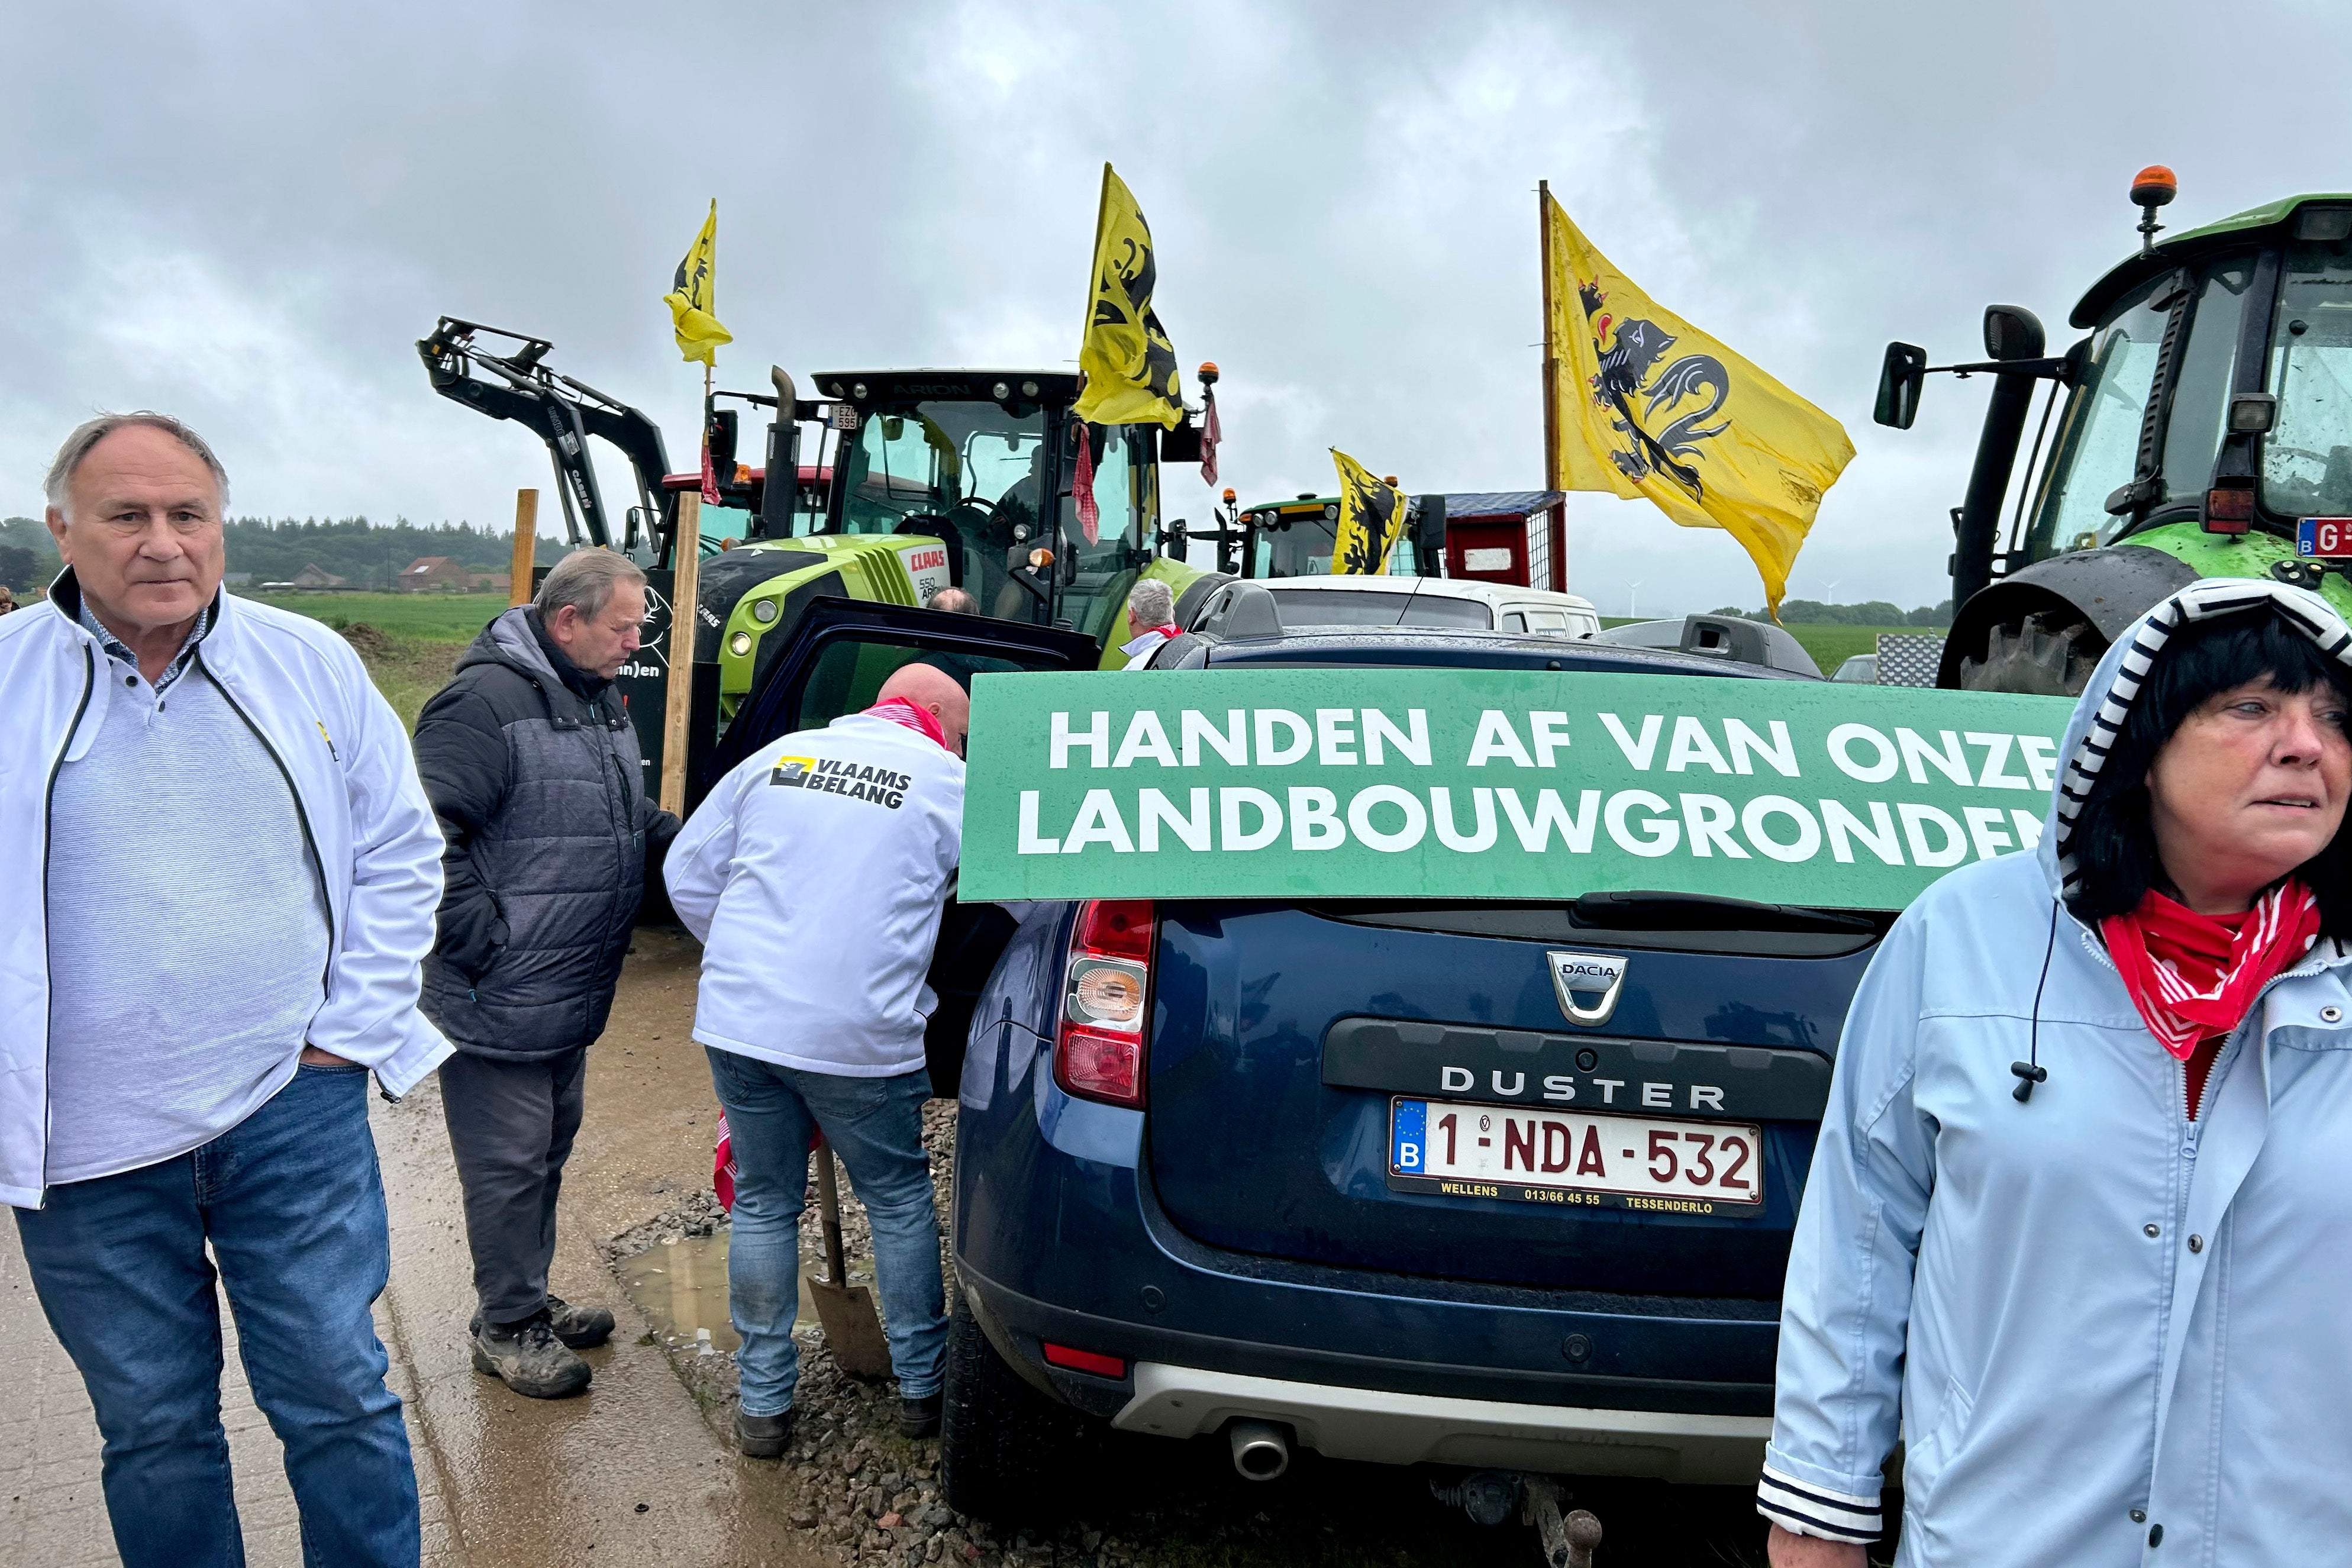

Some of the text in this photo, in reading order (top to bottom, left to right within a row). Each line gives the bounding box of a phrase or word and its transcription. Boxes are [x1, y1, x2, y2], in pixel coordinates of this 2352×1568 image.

[893, 385, 972, 395] ARION
[838, 418, 856, 428] 595
[572, 469, 588, 498] CASE
[2301, 540, 2312, 553] B
[911, 550, 944, 572] CLAAS
[919, 577, 935, 589] 550
[698, 604, 721, 628] LAAS
[1050, 709, 2058, 791] HANDEN AF VAN ONZE
[817, 759, 912, 791] VLAAMS
[806, 774, 904, 809] BELANG
[1562, 964, 1616, 977] DACIA
[1441, 1066, 1725, 1111] DUSTER
[1400, 1142, 1419, 1167] B
[1441, 1183, 1712, 1213] WELLENS 013/66 45 55 TESSENDERLO
